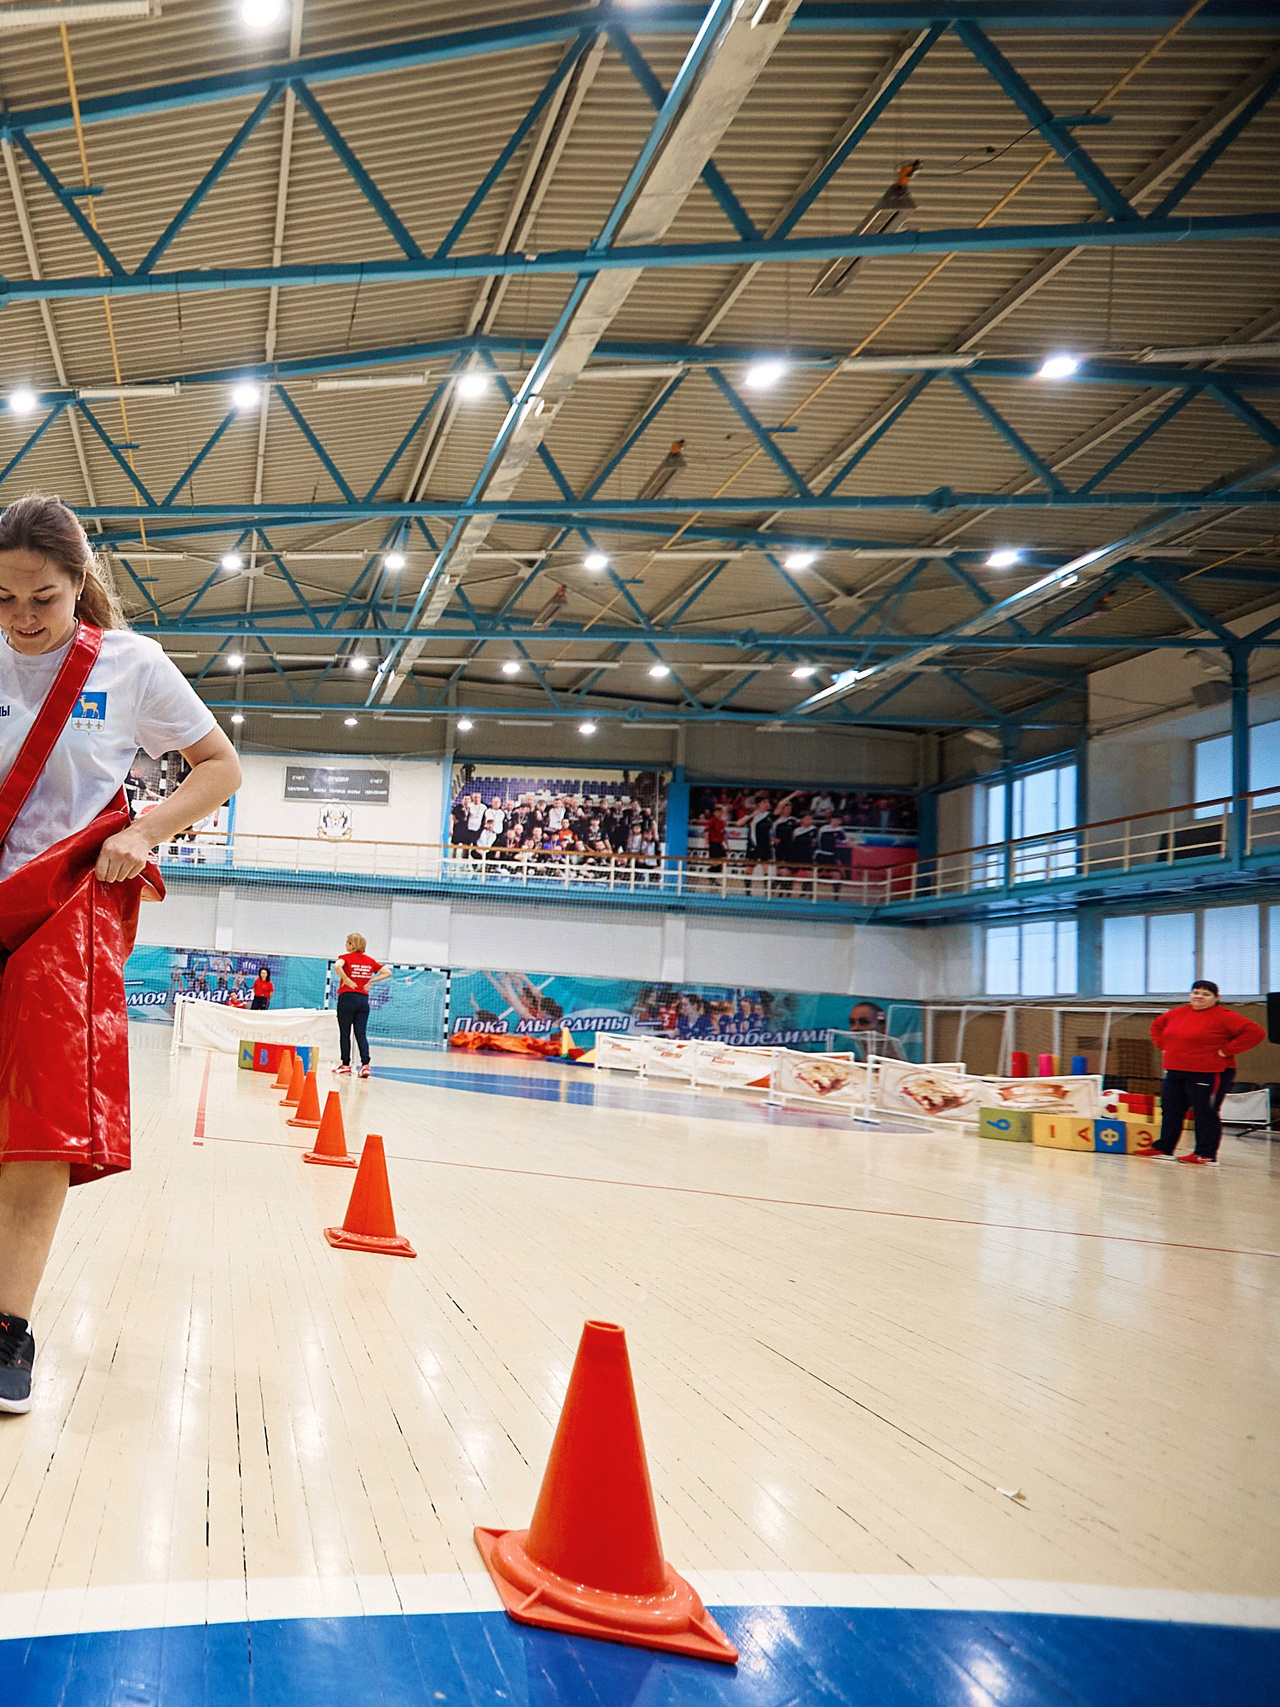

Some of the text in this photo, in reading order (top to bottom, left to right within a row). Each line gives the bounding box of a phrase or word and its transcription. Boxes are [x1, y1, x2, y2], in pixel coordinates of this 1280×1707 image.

[127, 991, 167, 1007] моя
[453, 1016, 509, 1034] Пока
[515, 1017, 552, 1033] мы
[559, 1016, 630, 1032] едины
